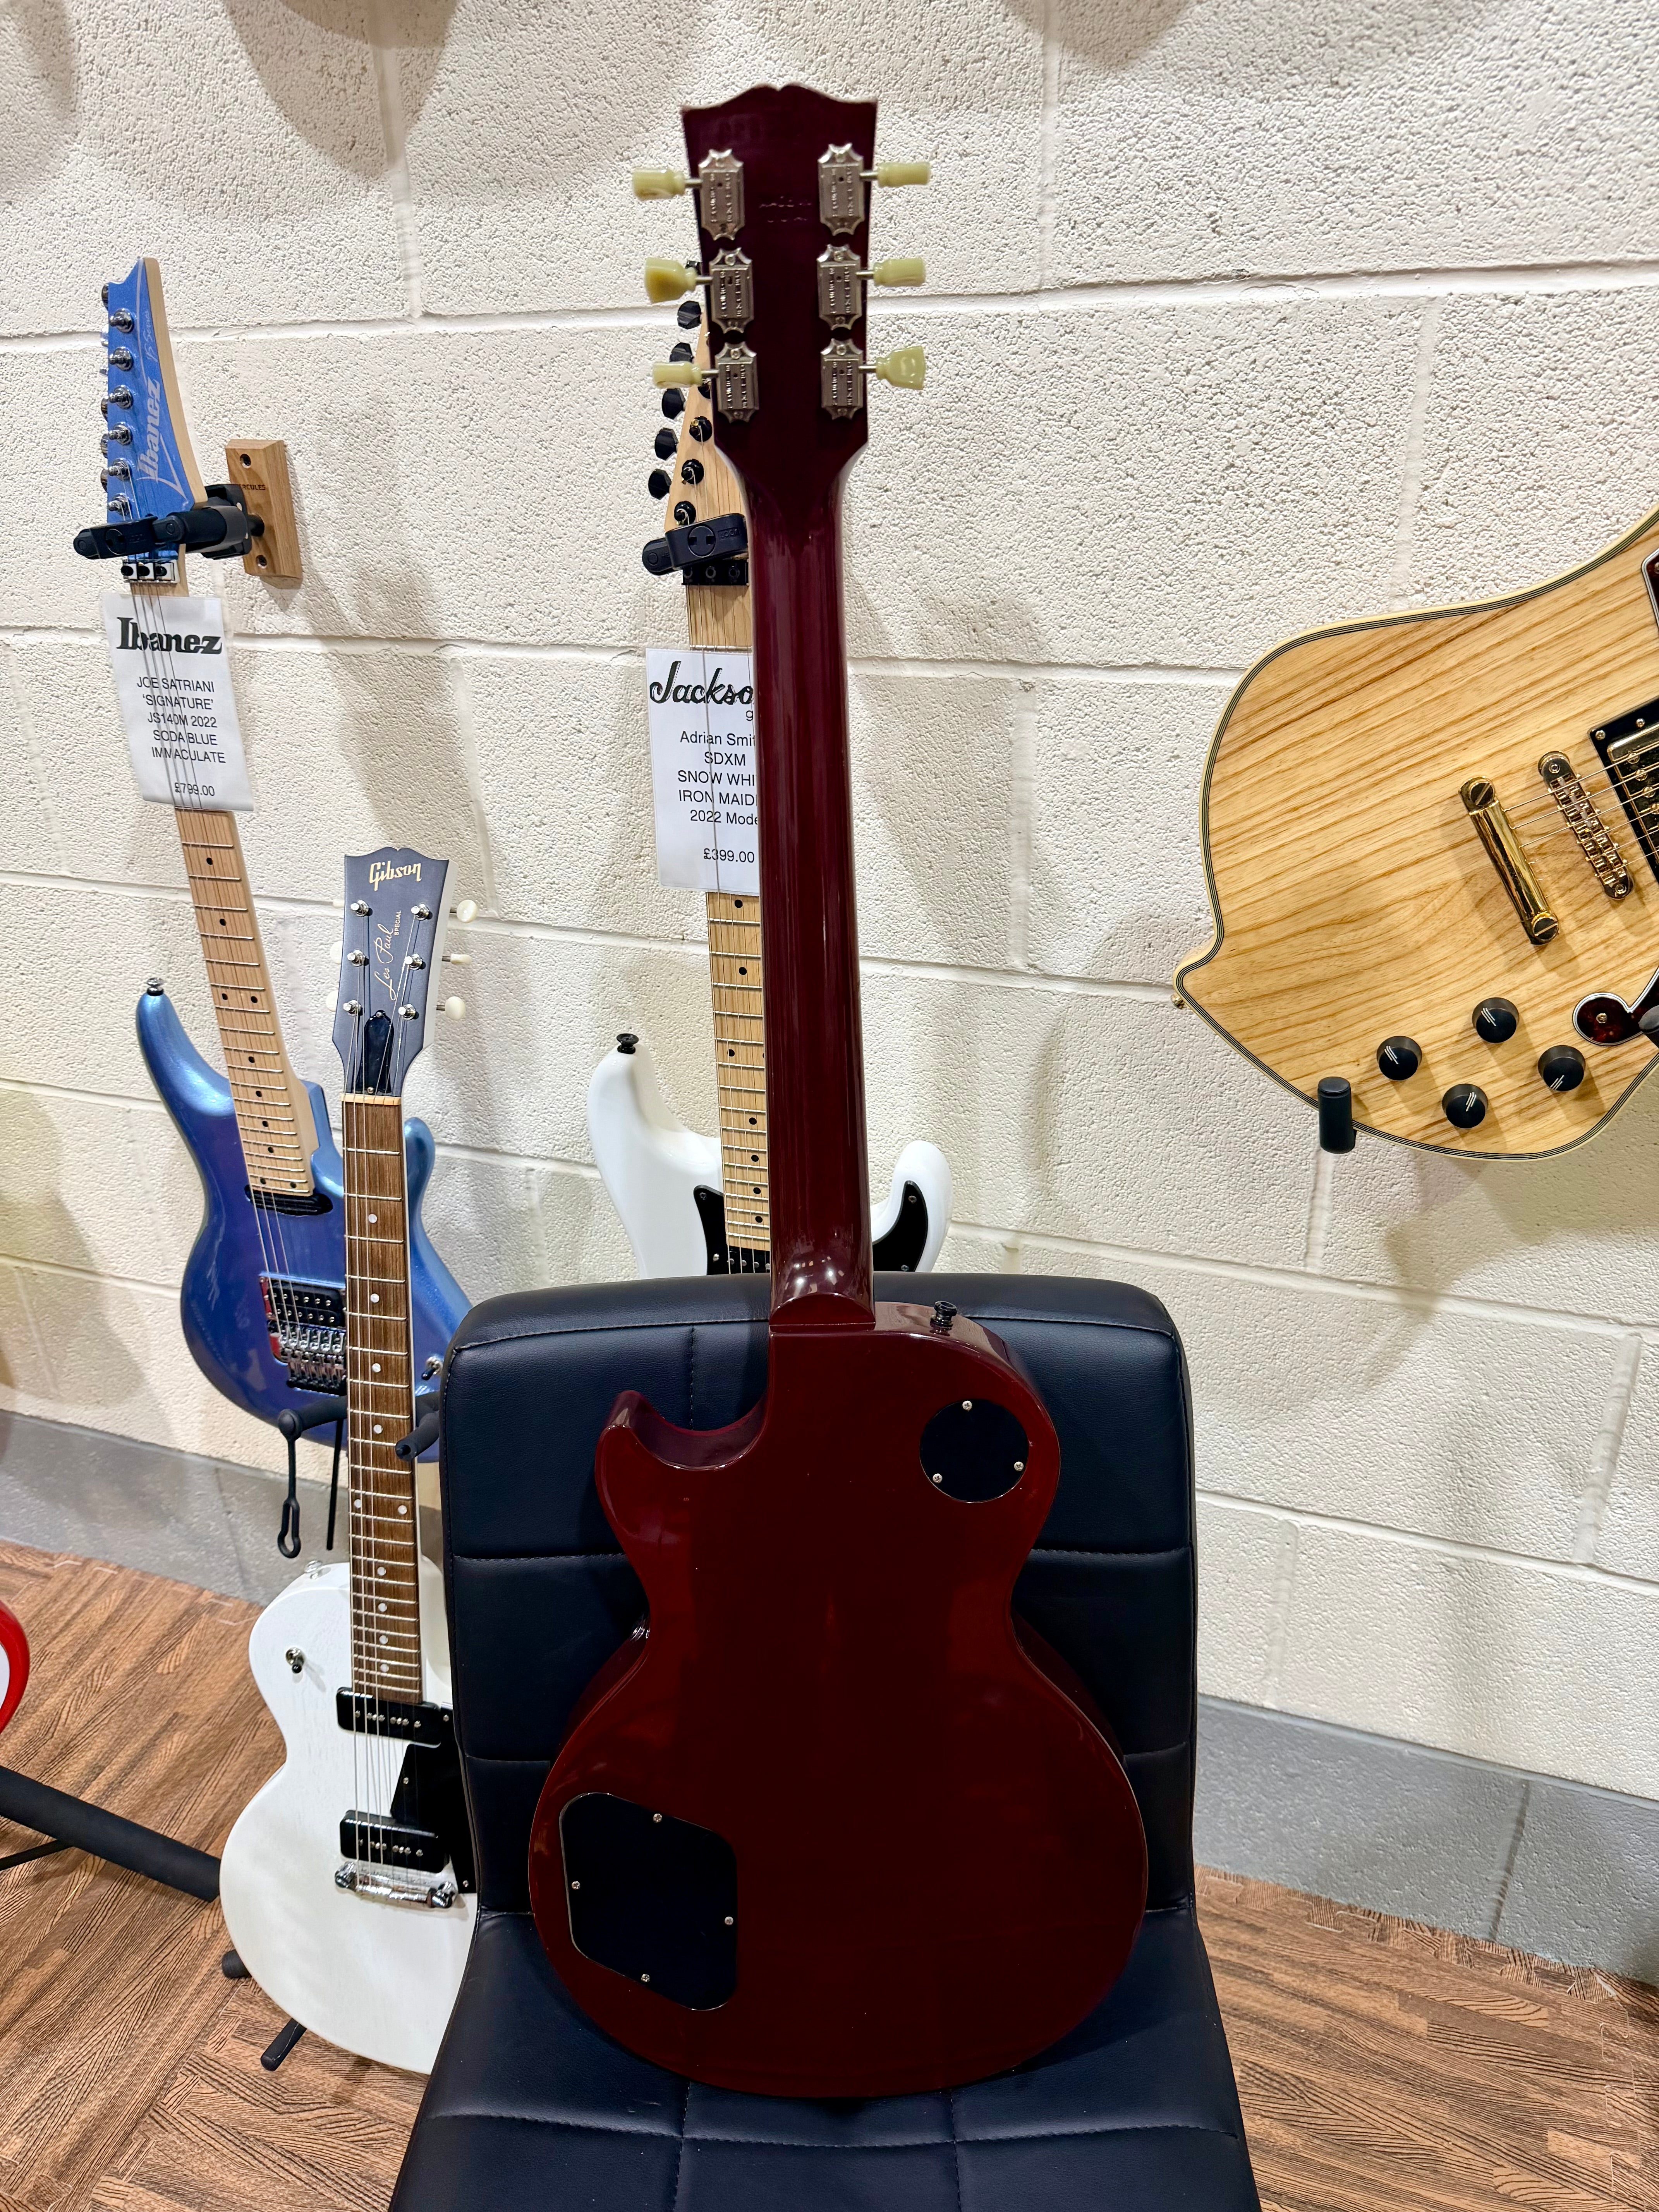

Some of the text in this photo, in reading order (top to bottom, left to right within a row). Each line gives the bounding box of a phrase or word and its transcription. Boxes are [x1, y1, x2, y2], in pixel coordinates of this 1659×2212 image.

[137, 376, 160, 484] Ibanez
[116, 617, 223, 654] Ibanez
[137, 677, 215, 692] JOE SATRIANI
[649, 661, 754, 705] Jackso
[191, 716, 218, 728] 2022
[153, 730, 218, 745] SODA BLUE
[680, 730, 722, 745] Adrian
[151, 747, 226, 763] IMMACULATE
[704, 751, 746, 766] SDXM
[678, 769, 755, 787] SNOW WHI
[174, 782, 215, 797] £799.00
[679, 789, 757, 806] IRON MAID
[690, 809, 758, 825] 2022 Mode
[703, 848, 755, 864] £399.00
[369, 860, 422, 891] Gibson
[373, 923, 397, 1001] Les Paul
